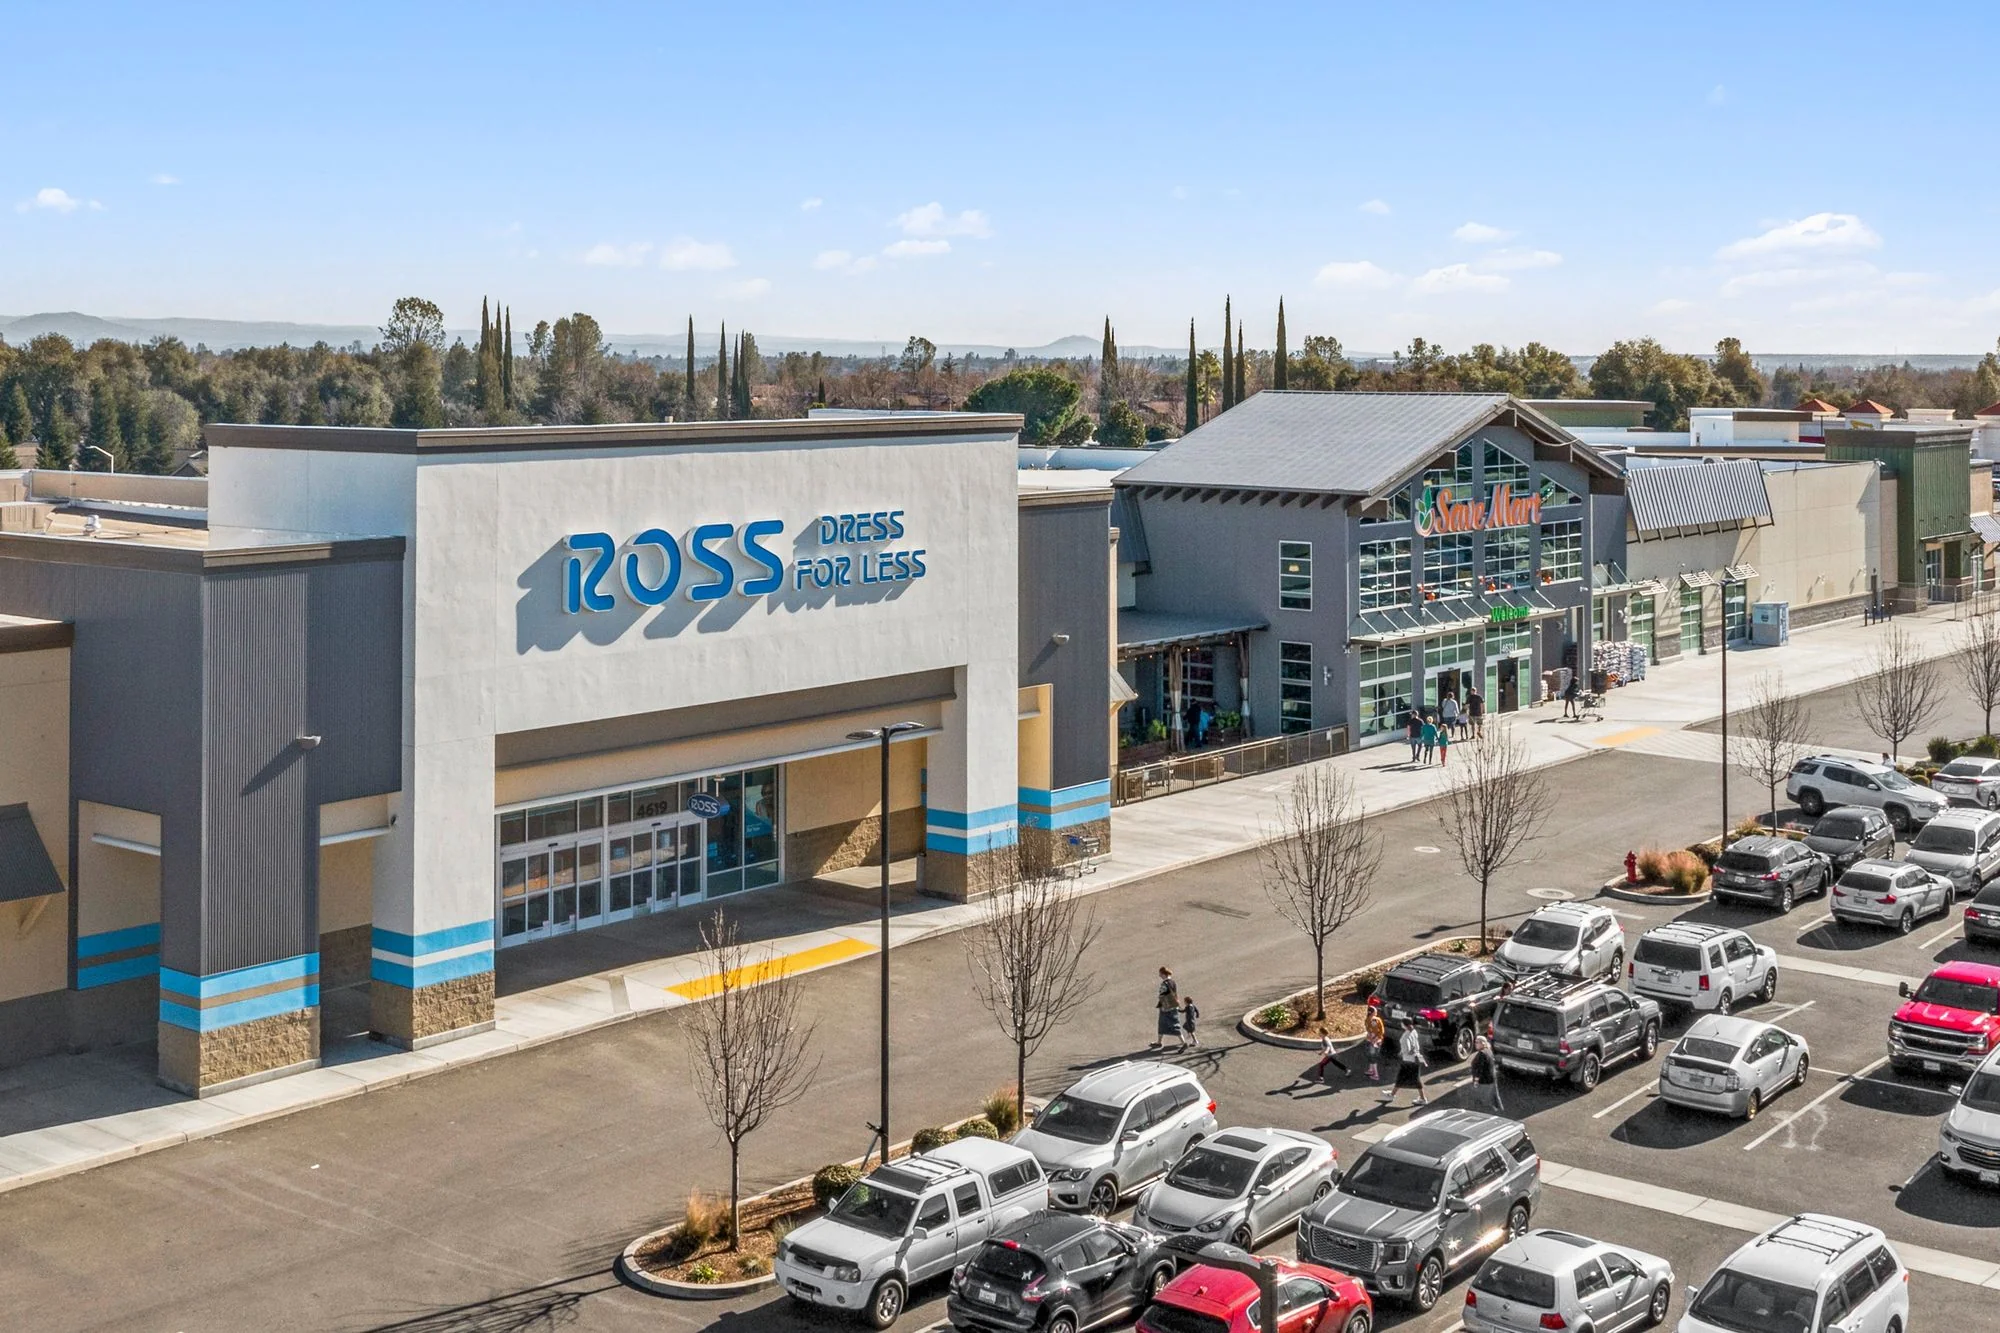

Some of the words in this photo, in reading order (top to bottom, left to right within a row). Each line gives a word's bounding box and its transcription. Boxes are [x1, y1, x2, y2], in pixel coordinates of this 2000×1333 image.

[818, 510, 904, 545] DRESS
[1435, 486, 1485, 534] Save
[1485, 483, 1541, 530] Mart
[562, 519, 784, 614] ROSS
[793, 556, 851, 591] FOR
[859, 549, 926, 584] LESS
[636, 800, 668, 818] 4619
[690, 799, 718, 814] ROSS
